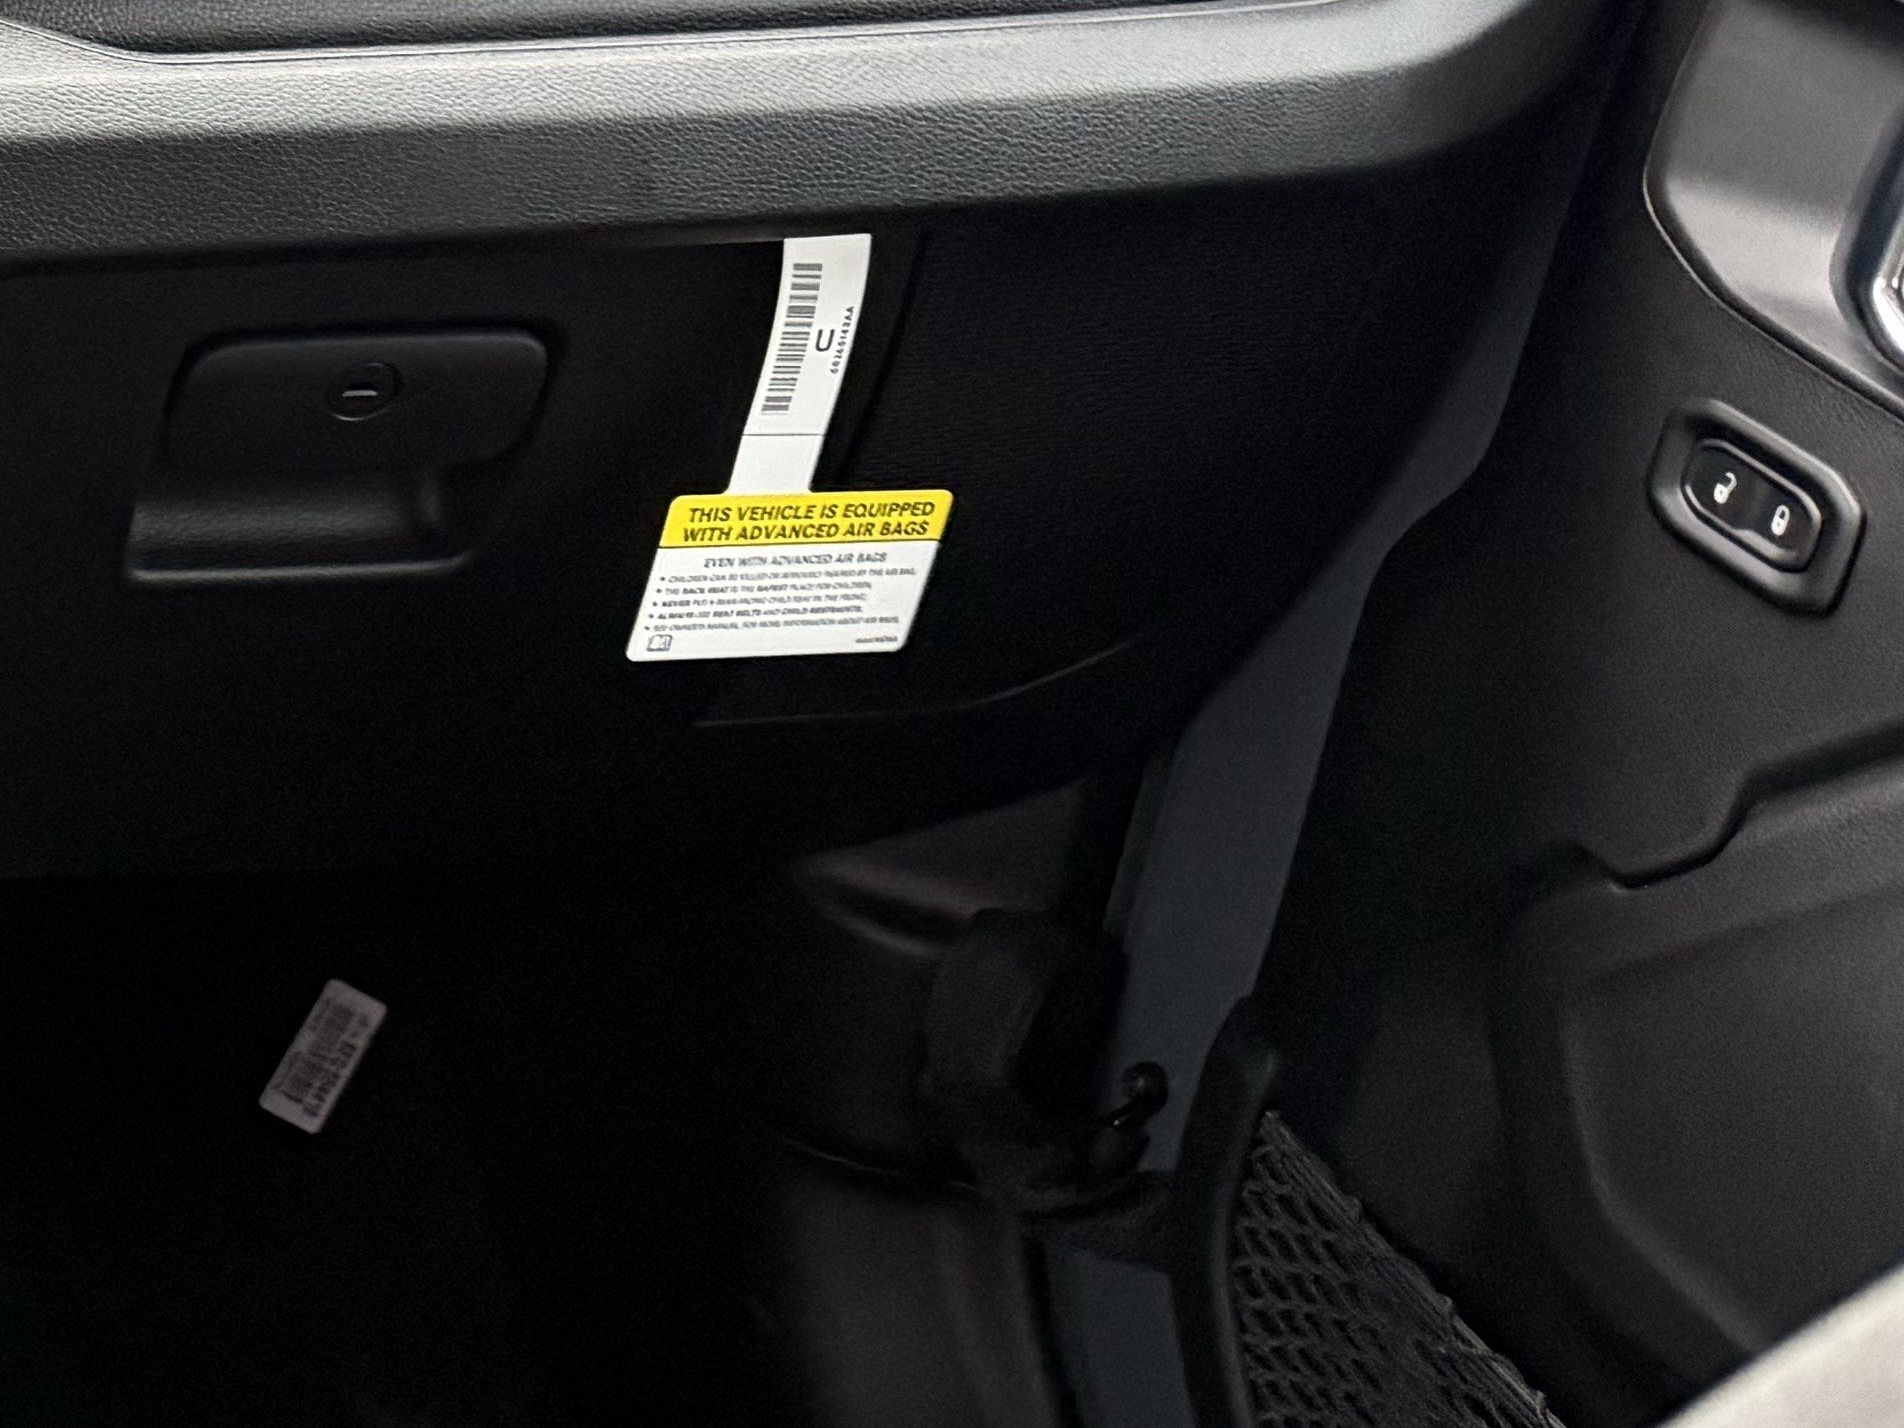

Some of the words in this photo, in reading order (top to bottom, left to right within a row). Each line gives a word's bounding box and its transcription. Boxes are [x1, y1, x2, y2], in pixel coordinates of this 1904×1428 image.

[688, 506, 732, 523] THIS
[737, 504, 817, 522] VEHICLE
[819, 503, 839, 519] IS
[841, 500, 936, 518] EQUIPPED
[683, 526, 732, 542] WITH
[736, 524, 840, 541] ADVANCED
[843, 522, 875, 538] AIR
[878, 520, 930, 536] BAGS
